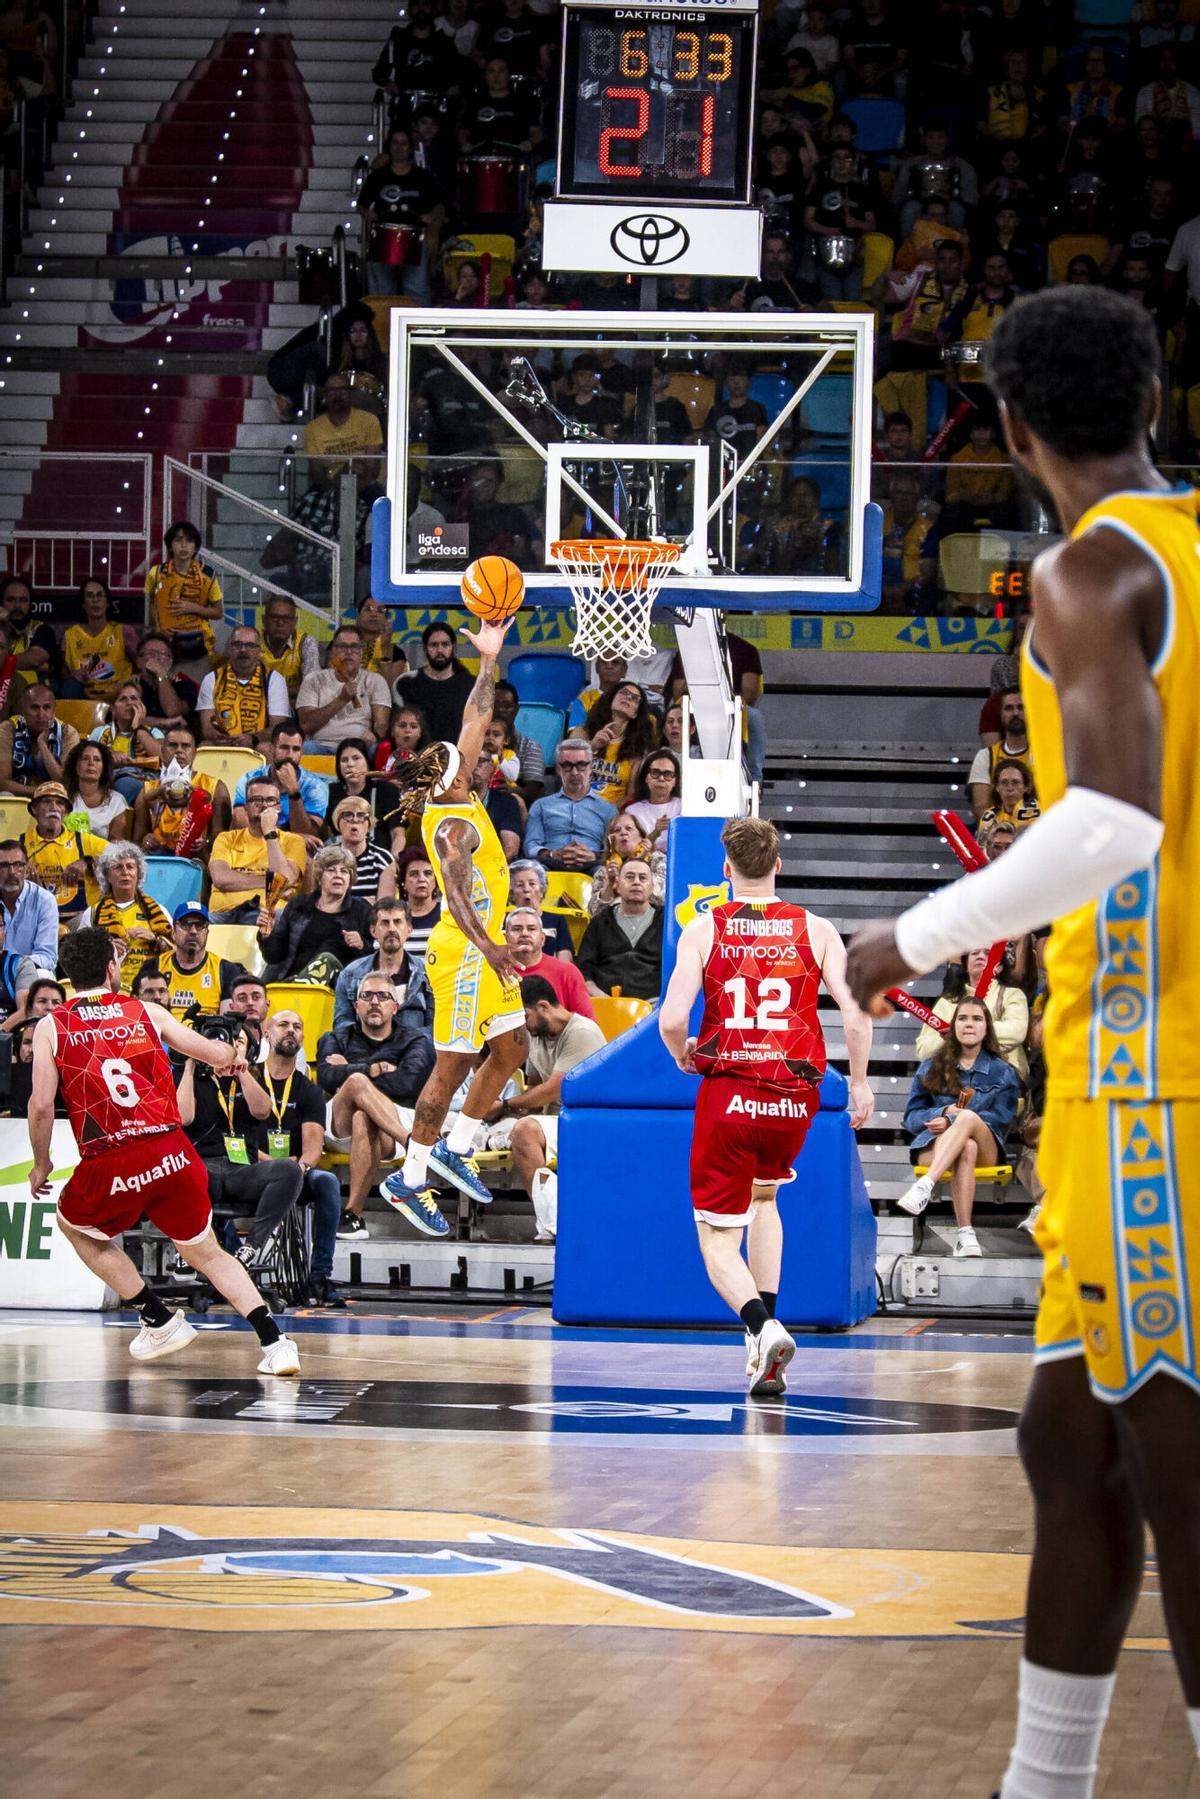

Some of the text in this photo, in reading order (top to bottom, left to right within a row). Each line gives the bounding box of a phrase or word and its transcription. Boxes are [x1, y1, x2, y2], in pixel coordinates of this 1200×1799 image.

[615, 10, 706, 22] DAKTRONICS
[600, 87, 714, 177] 21
[418, 533, 441, 546] liga
[418, 544, 467, 556] endesa
[726, 918, 794, 937] STEINBERGS
[77, 1002, 124, 1021] BASSAS
[724, 977, 791, 1031] 12
[897, 993, 929, 1021] TOYOTA
[101, 1058, 141, 1109] 6
[725, 1094, 809, 1120] Aquaflix
[109, 1150, 192, 1197] Aquaflix
